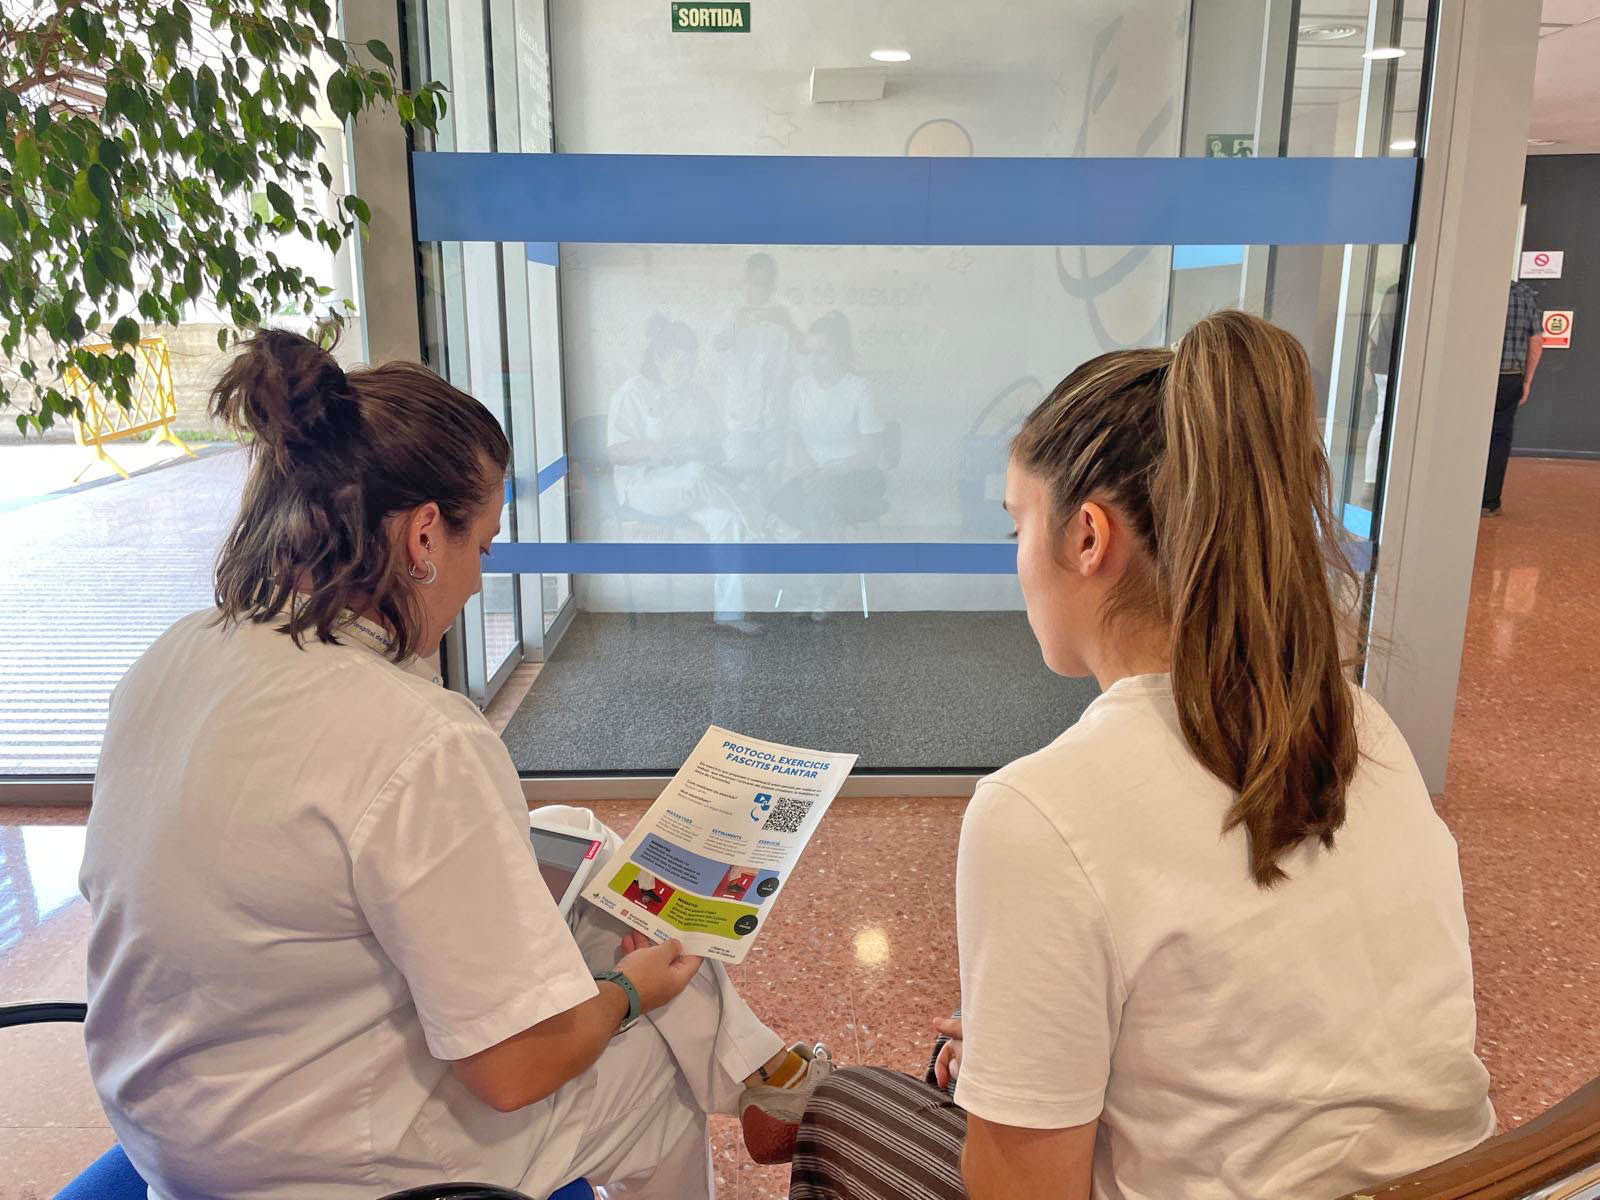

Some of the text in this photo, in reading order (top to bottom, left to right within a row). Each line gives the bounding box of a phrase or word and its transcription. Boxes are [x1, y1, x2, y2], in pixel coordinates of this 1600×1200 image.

[679, 8, 744, 27] SORTIDA
[722, 741, 830, 771] PROTOCOL EXERCICIS
[726, 753, 818, 779] FASCITIS PLANTAR
